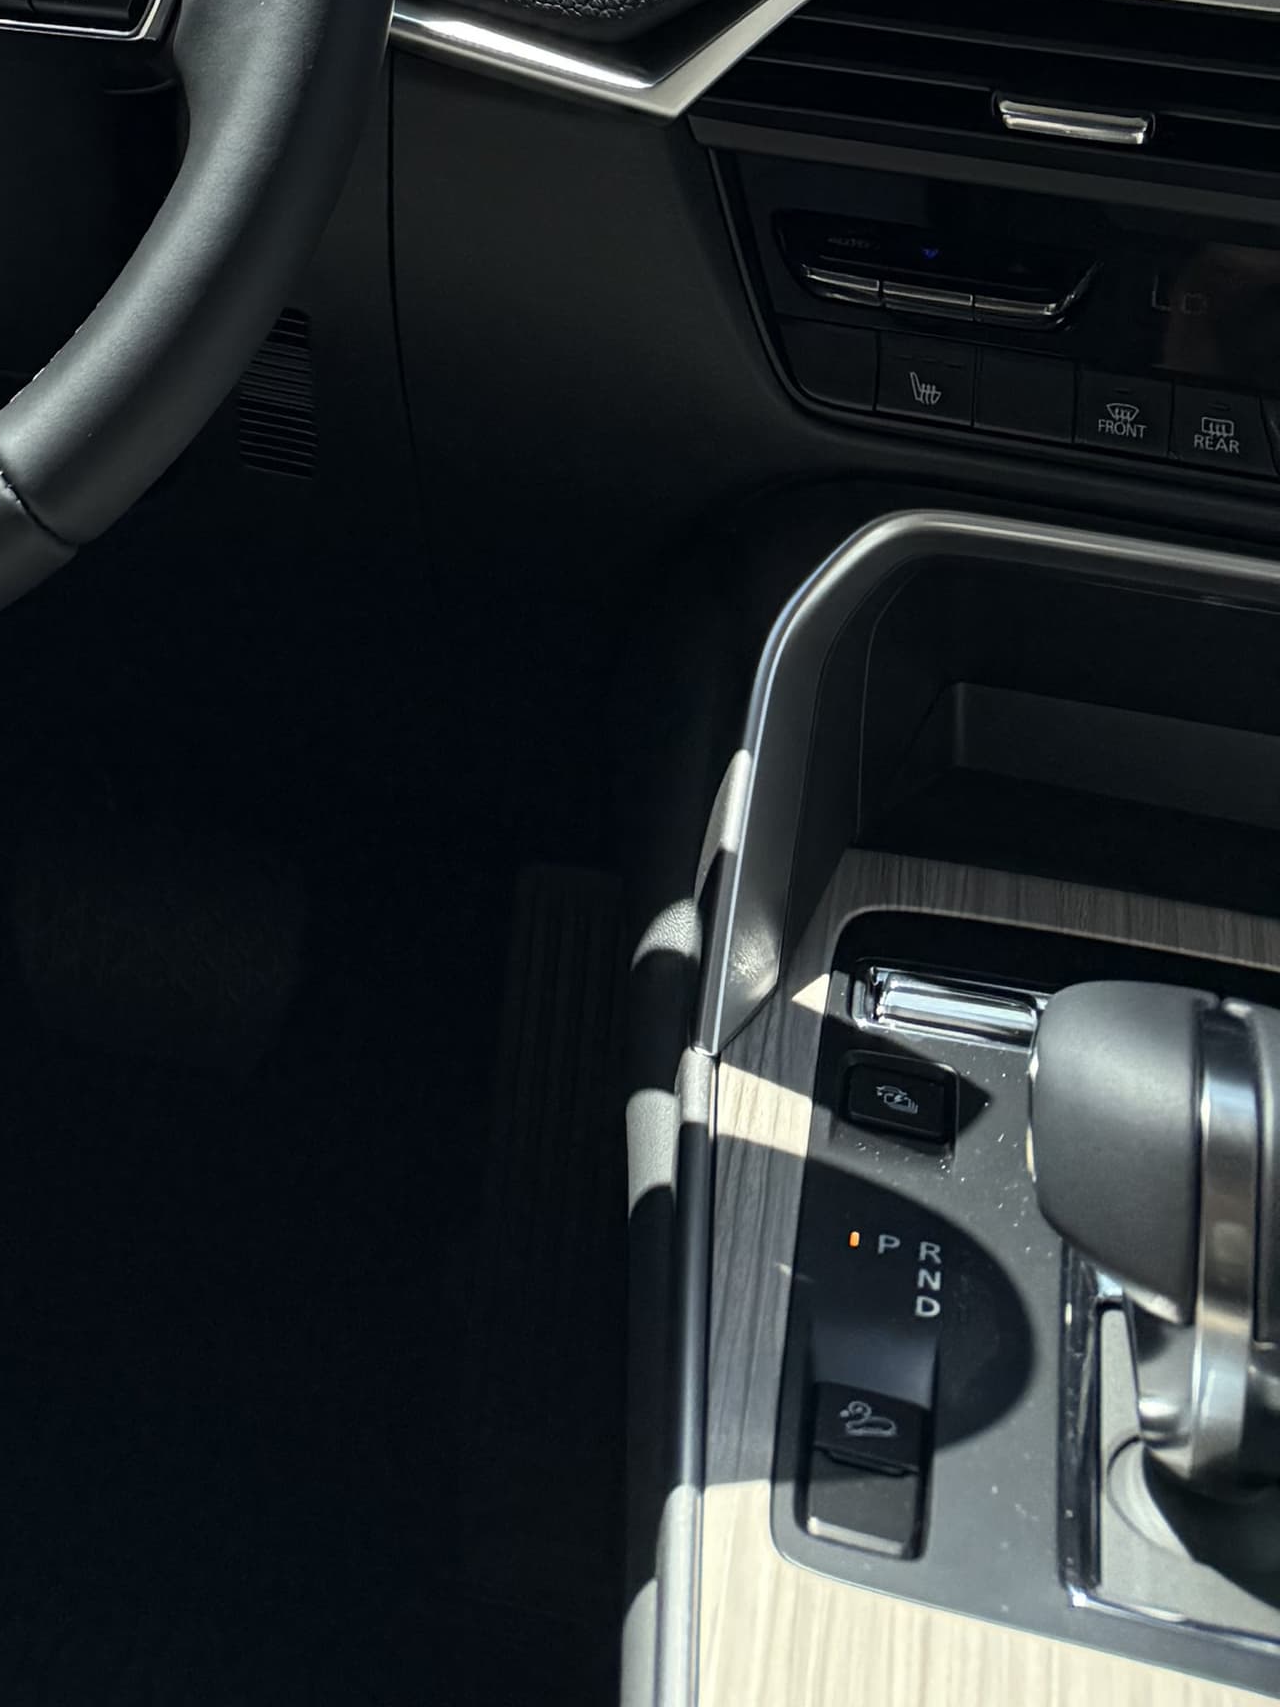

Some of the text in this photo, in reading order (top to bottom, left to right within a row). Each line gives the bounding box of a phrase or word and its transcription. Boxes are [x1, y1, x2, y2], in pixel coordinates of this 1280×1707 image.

[1097, 418, 1148, 439] FRONT
[1193, 433, 1240, 454] REAR
[877, 1233, 942, 1265] P R
[917, 1267, 942, 1291] N
[914, 1294, 941, 1318] D
